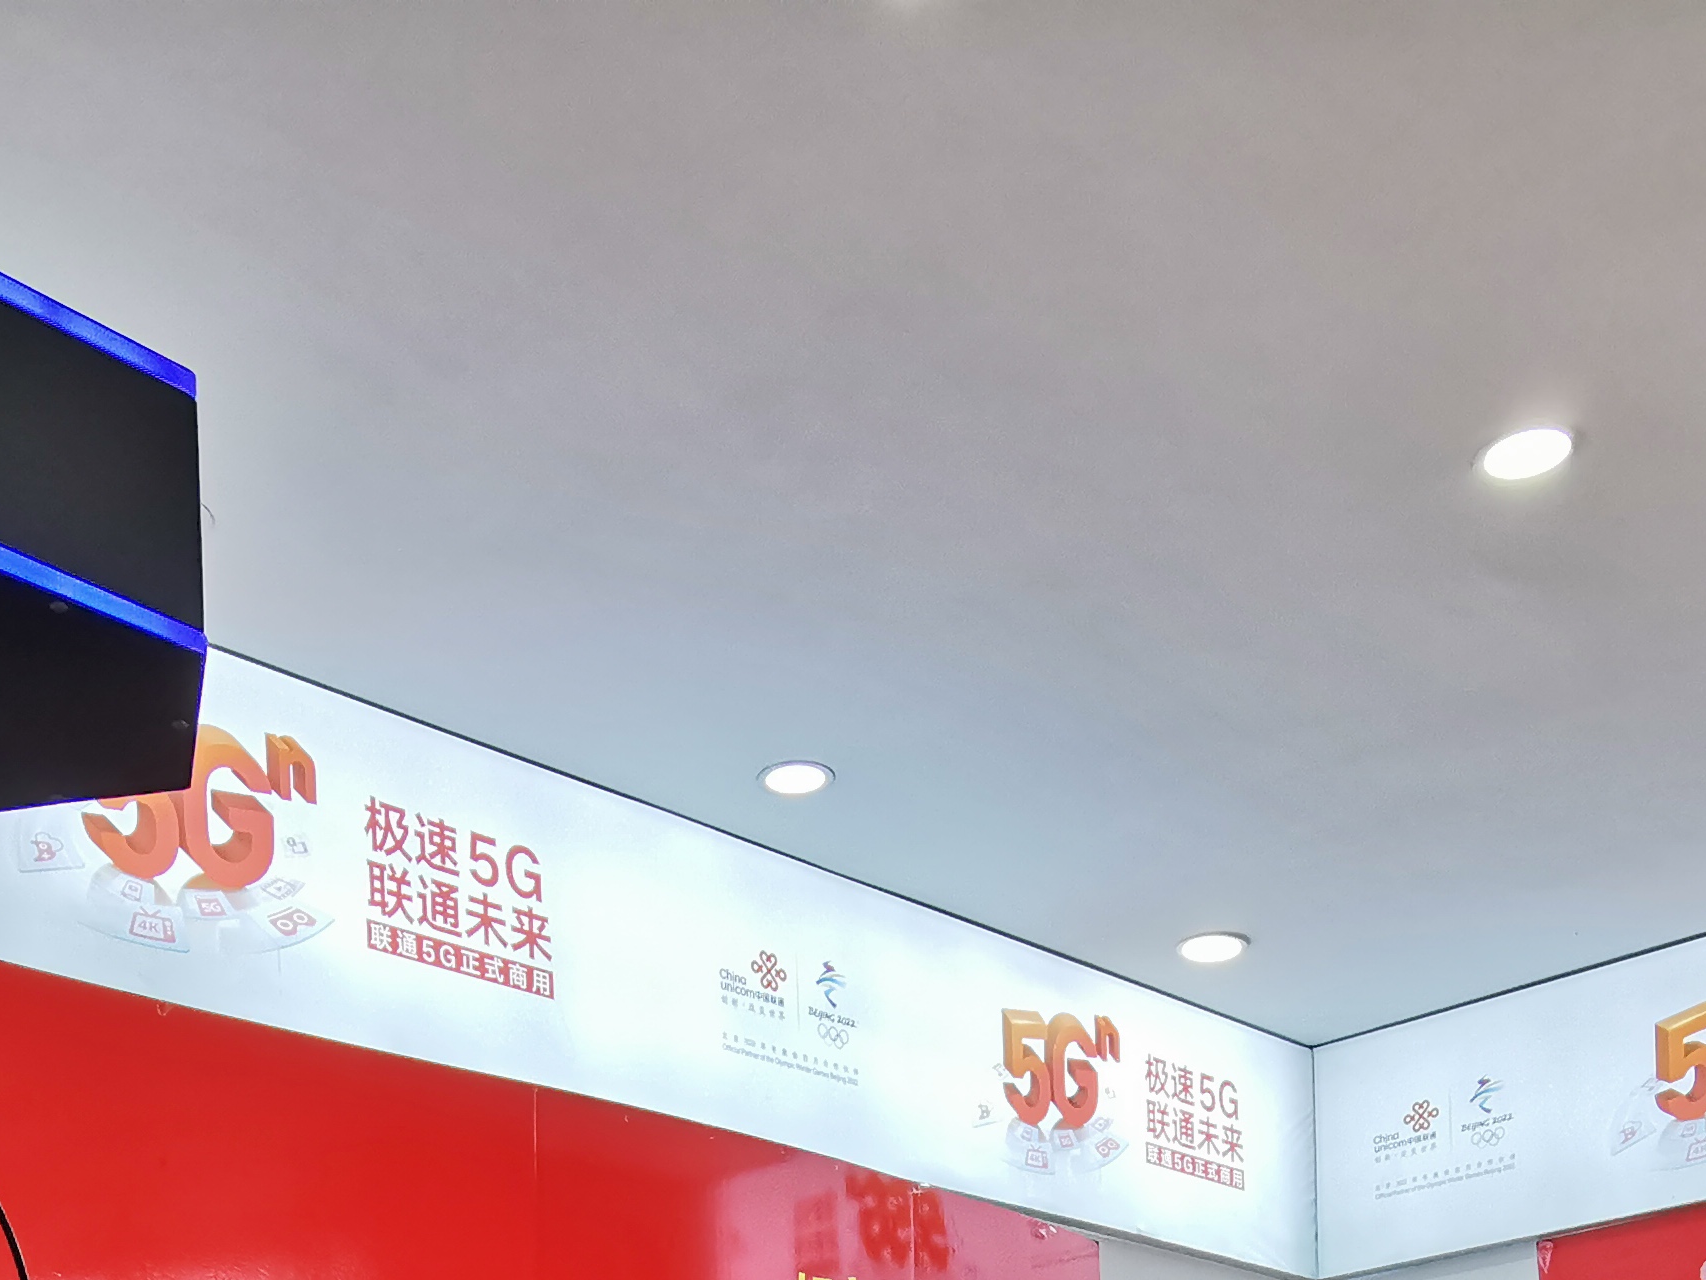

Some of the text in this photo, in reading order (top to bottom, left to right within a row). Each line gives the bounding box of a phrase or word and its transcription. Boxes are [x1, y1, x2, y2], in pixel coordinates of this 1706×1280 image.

[365, 795, 542, 902] 极速5G
[367, 860, 553, 961] 联通未来
[370, 923, 553, 997] 联通5G正式商用
[719, 968, 747, 985] China
[1145, 1053, 1239, 1121] 极速5G
[1146, 1099, 1244, 1163] 联通未来
[1373, 1132, 1400, 1145] China
[1146, 1145, 1244, 1189] 联通5G正式商用
